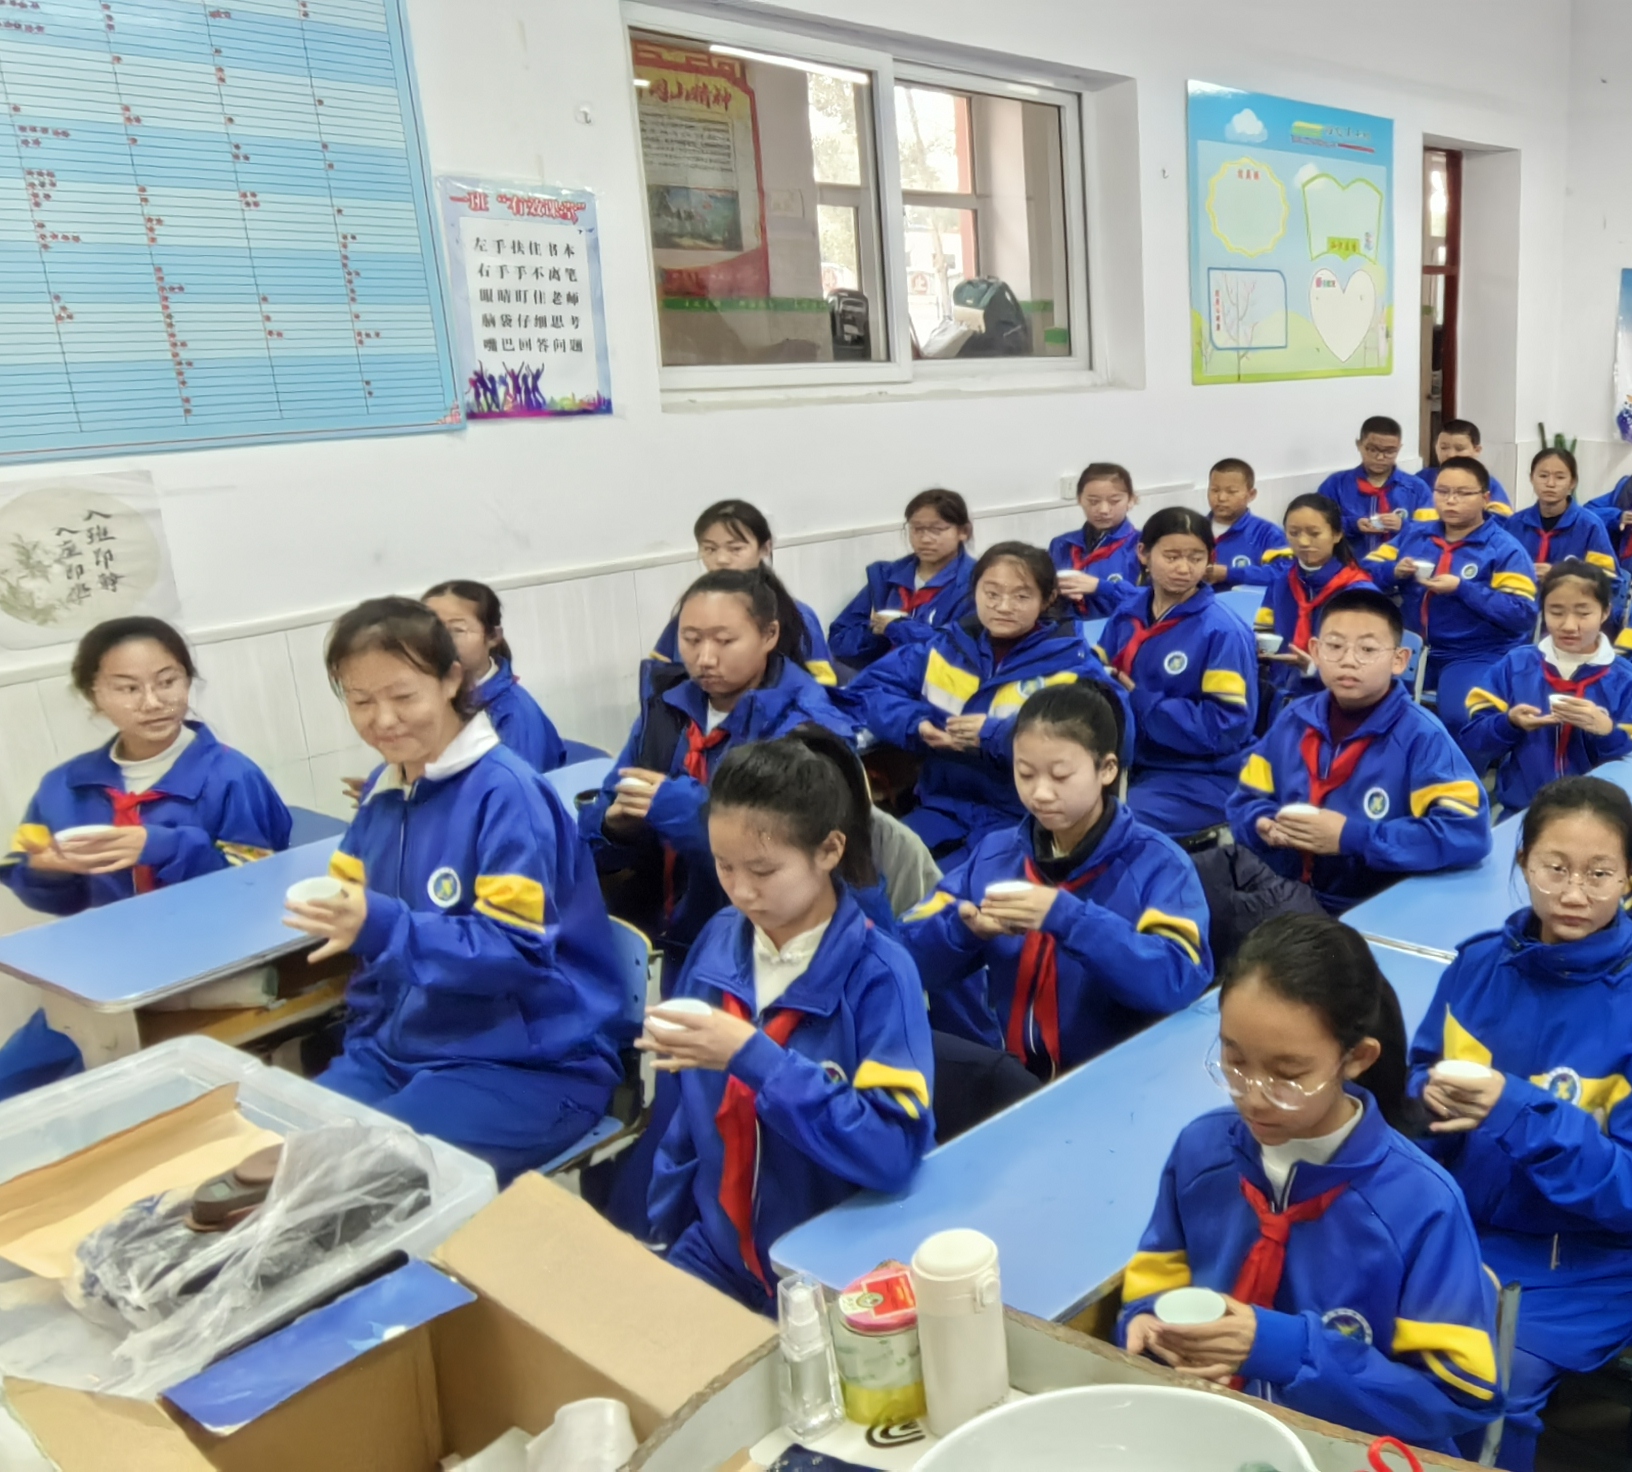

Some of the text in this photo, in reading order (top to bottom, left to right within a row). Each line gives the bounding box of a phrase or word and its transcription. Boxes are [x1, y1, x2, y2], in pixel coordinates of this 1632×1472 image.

[478, 262, 578, 283] 右手手不离笔
[479, 288, 579, 306] 眼睛盯住老师
[481, 313, 580, 330] 脑袋仔细思考
[483, 337, 583, 353] 嘴巴回答问题
